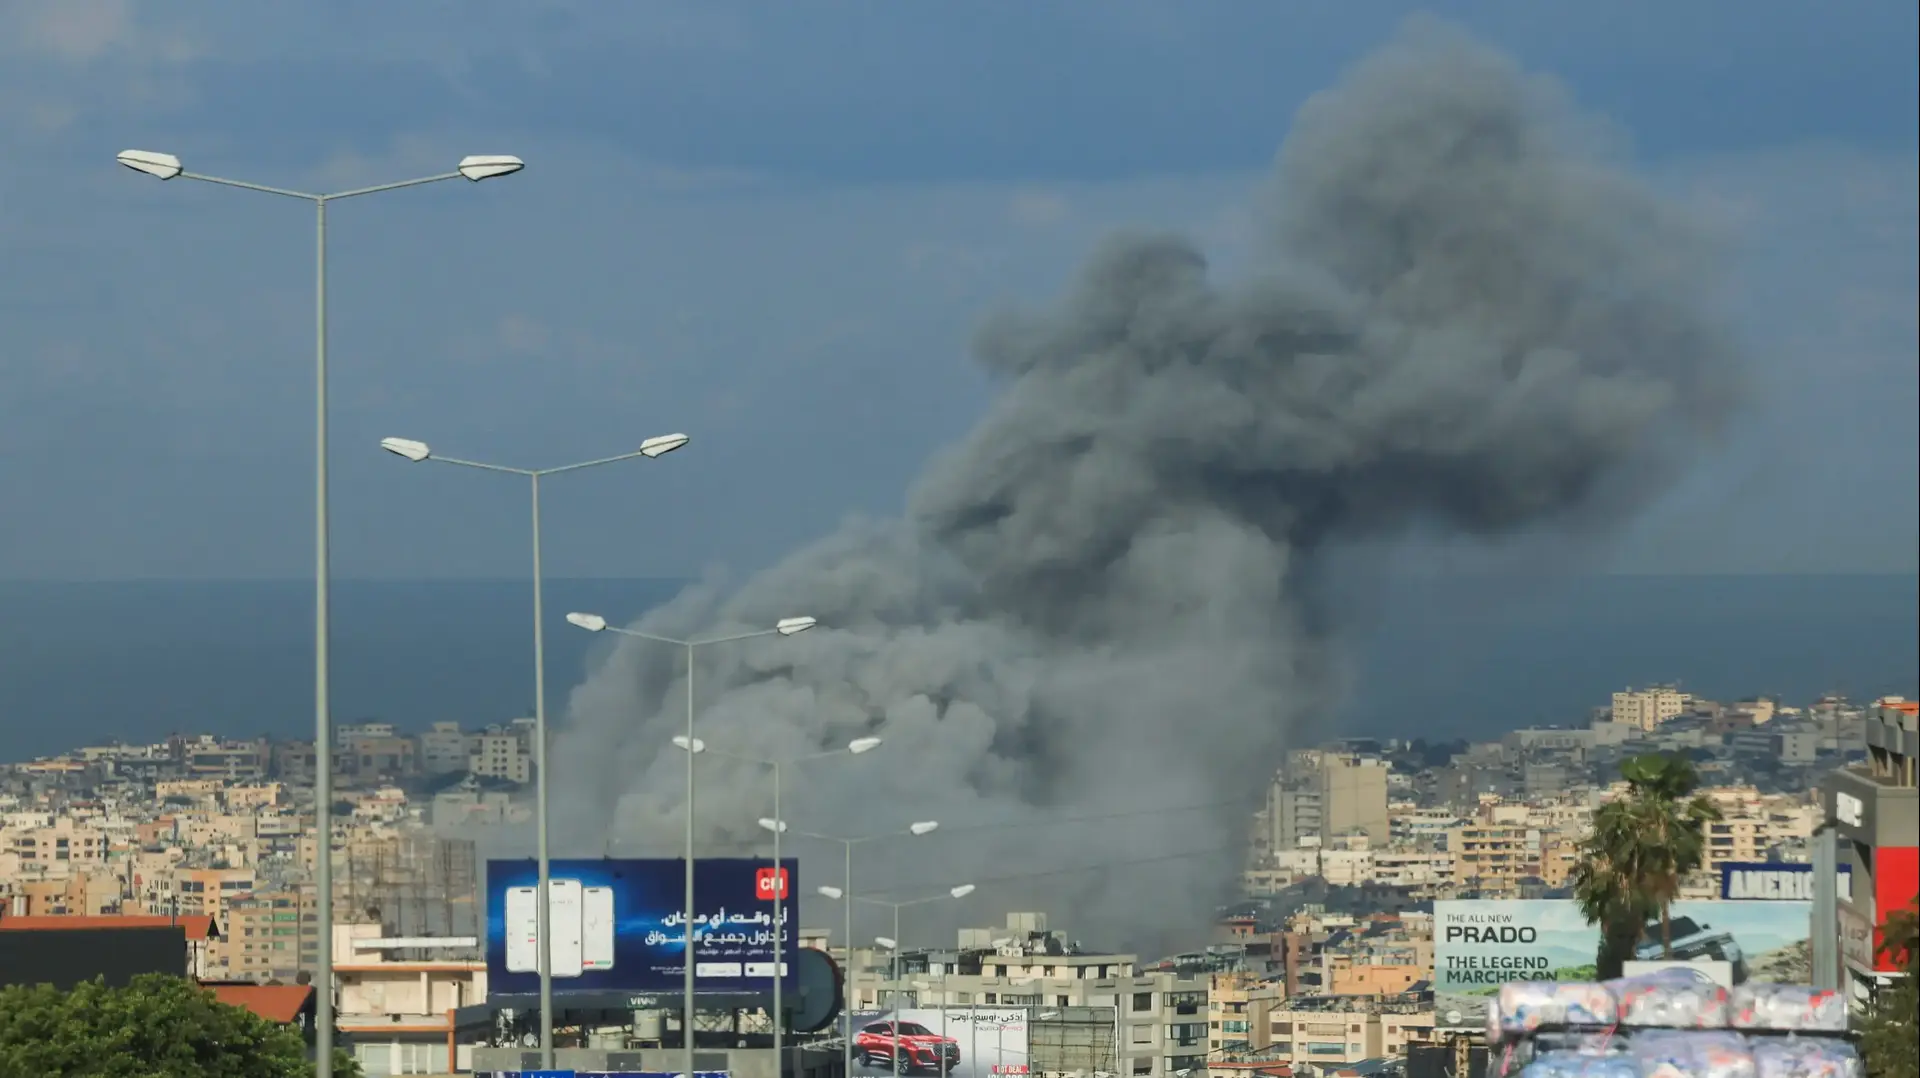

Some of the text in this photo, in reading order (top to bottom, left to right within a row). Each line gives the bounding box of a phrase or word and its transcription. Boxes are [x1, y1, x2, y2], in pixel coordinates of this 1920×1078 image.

[1728, 870, 1853, 903] AMERICN
[1447, 914, 1512, 923] THE ALL NEW
[1446, 926, 1537, 943] PRADO
[1446, 956, 1549, 969] THE LEGEND
[1446, 970, 1558, 983] MARCHES ON
